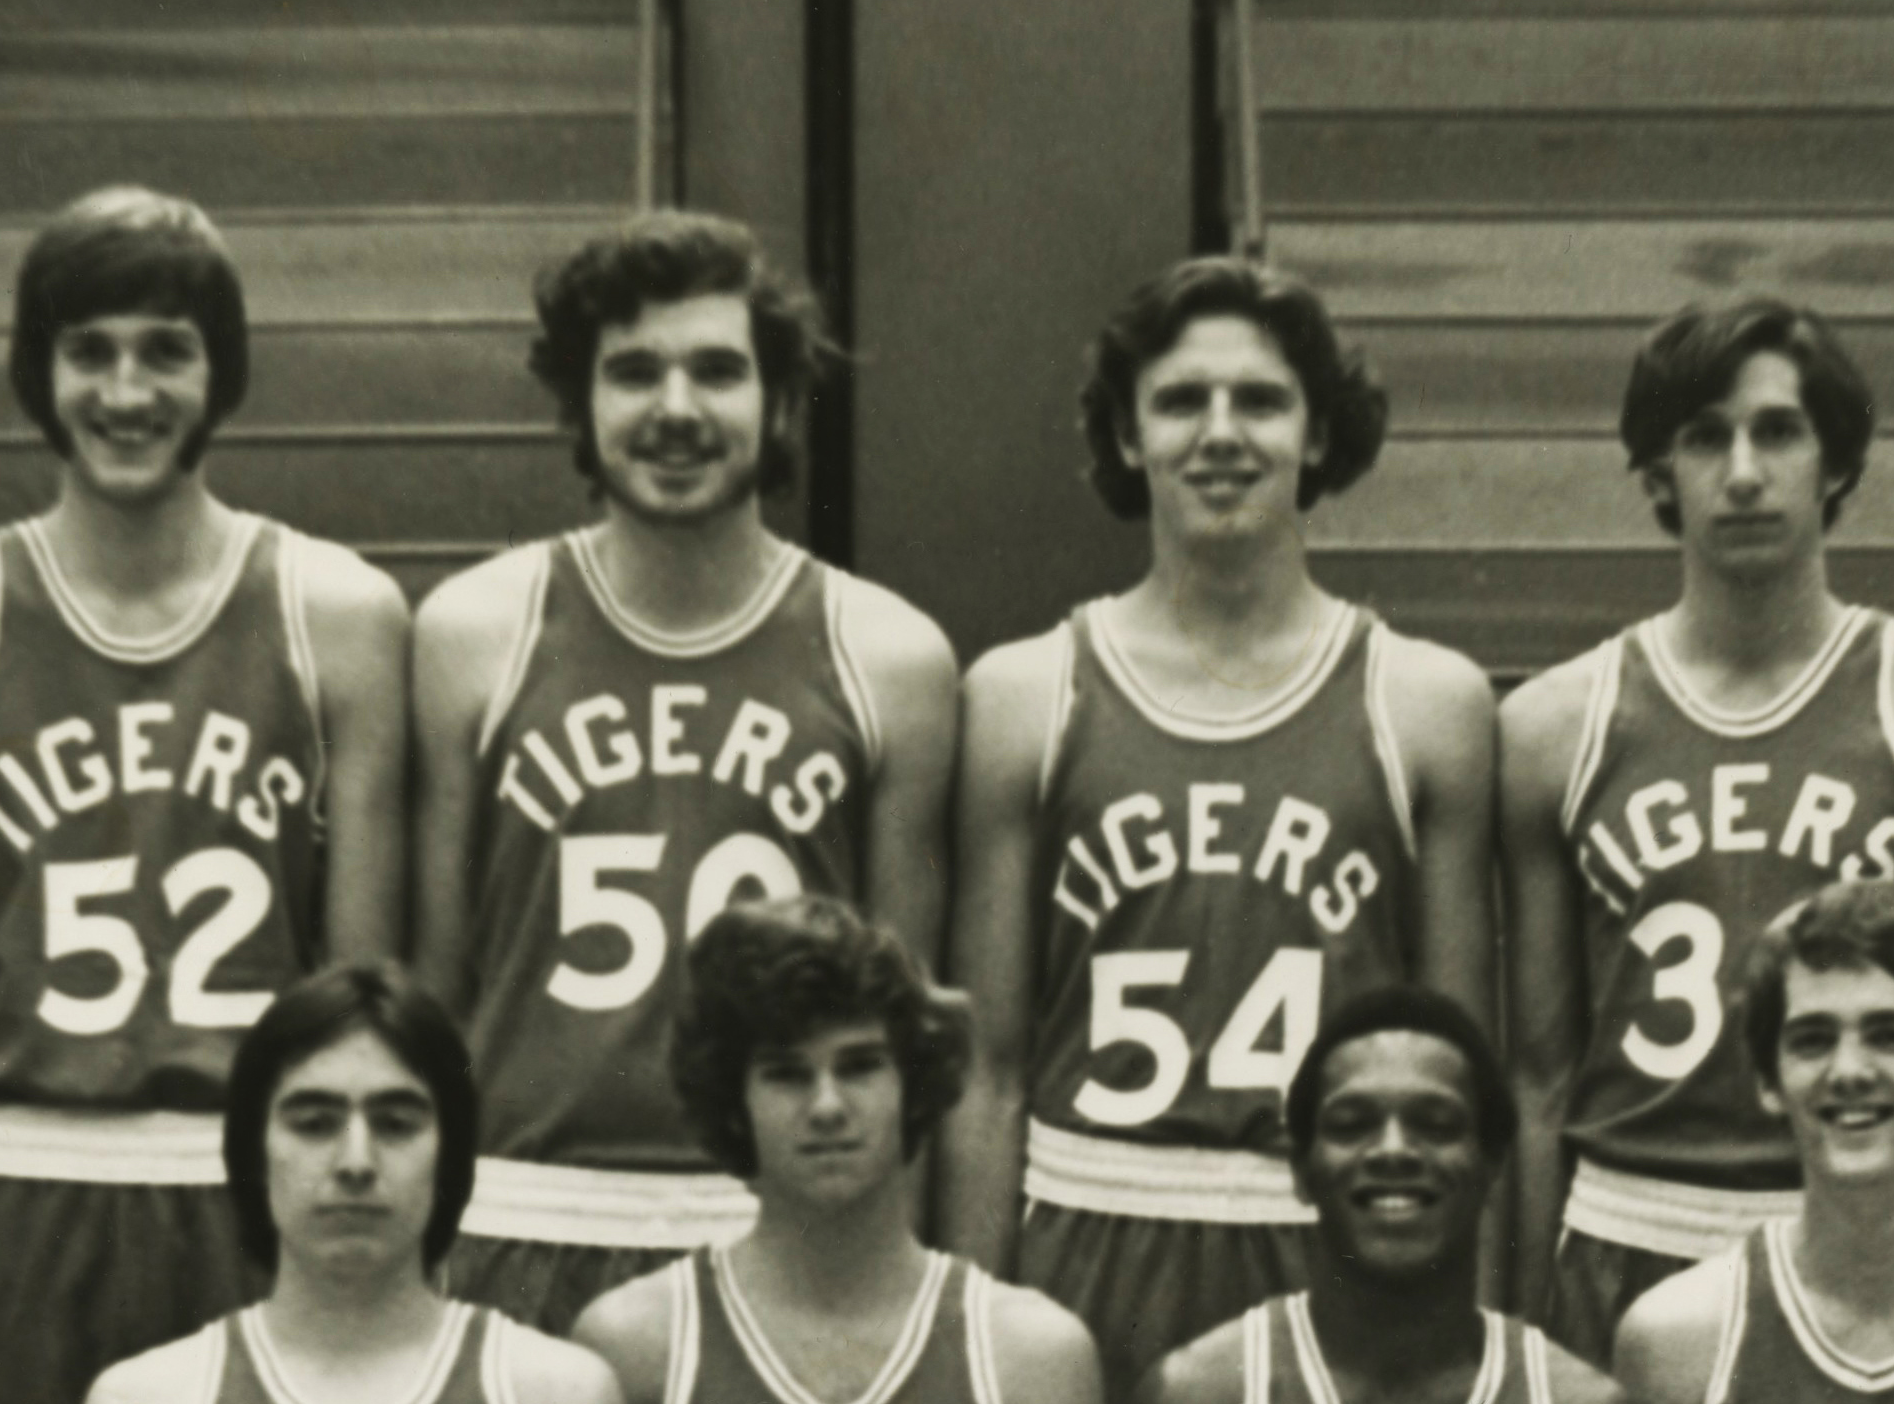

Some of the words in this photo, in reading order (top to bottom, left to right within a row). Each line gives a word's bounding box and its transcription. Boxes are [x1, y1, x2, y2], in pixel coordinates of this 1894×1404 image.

[497, 684, 845, 833] TIGERS
[1053, 782, 1380, 932] TIGERS
[37, 847, 276, 1036] 52
[1073, 946, 1324, 1126] 54
